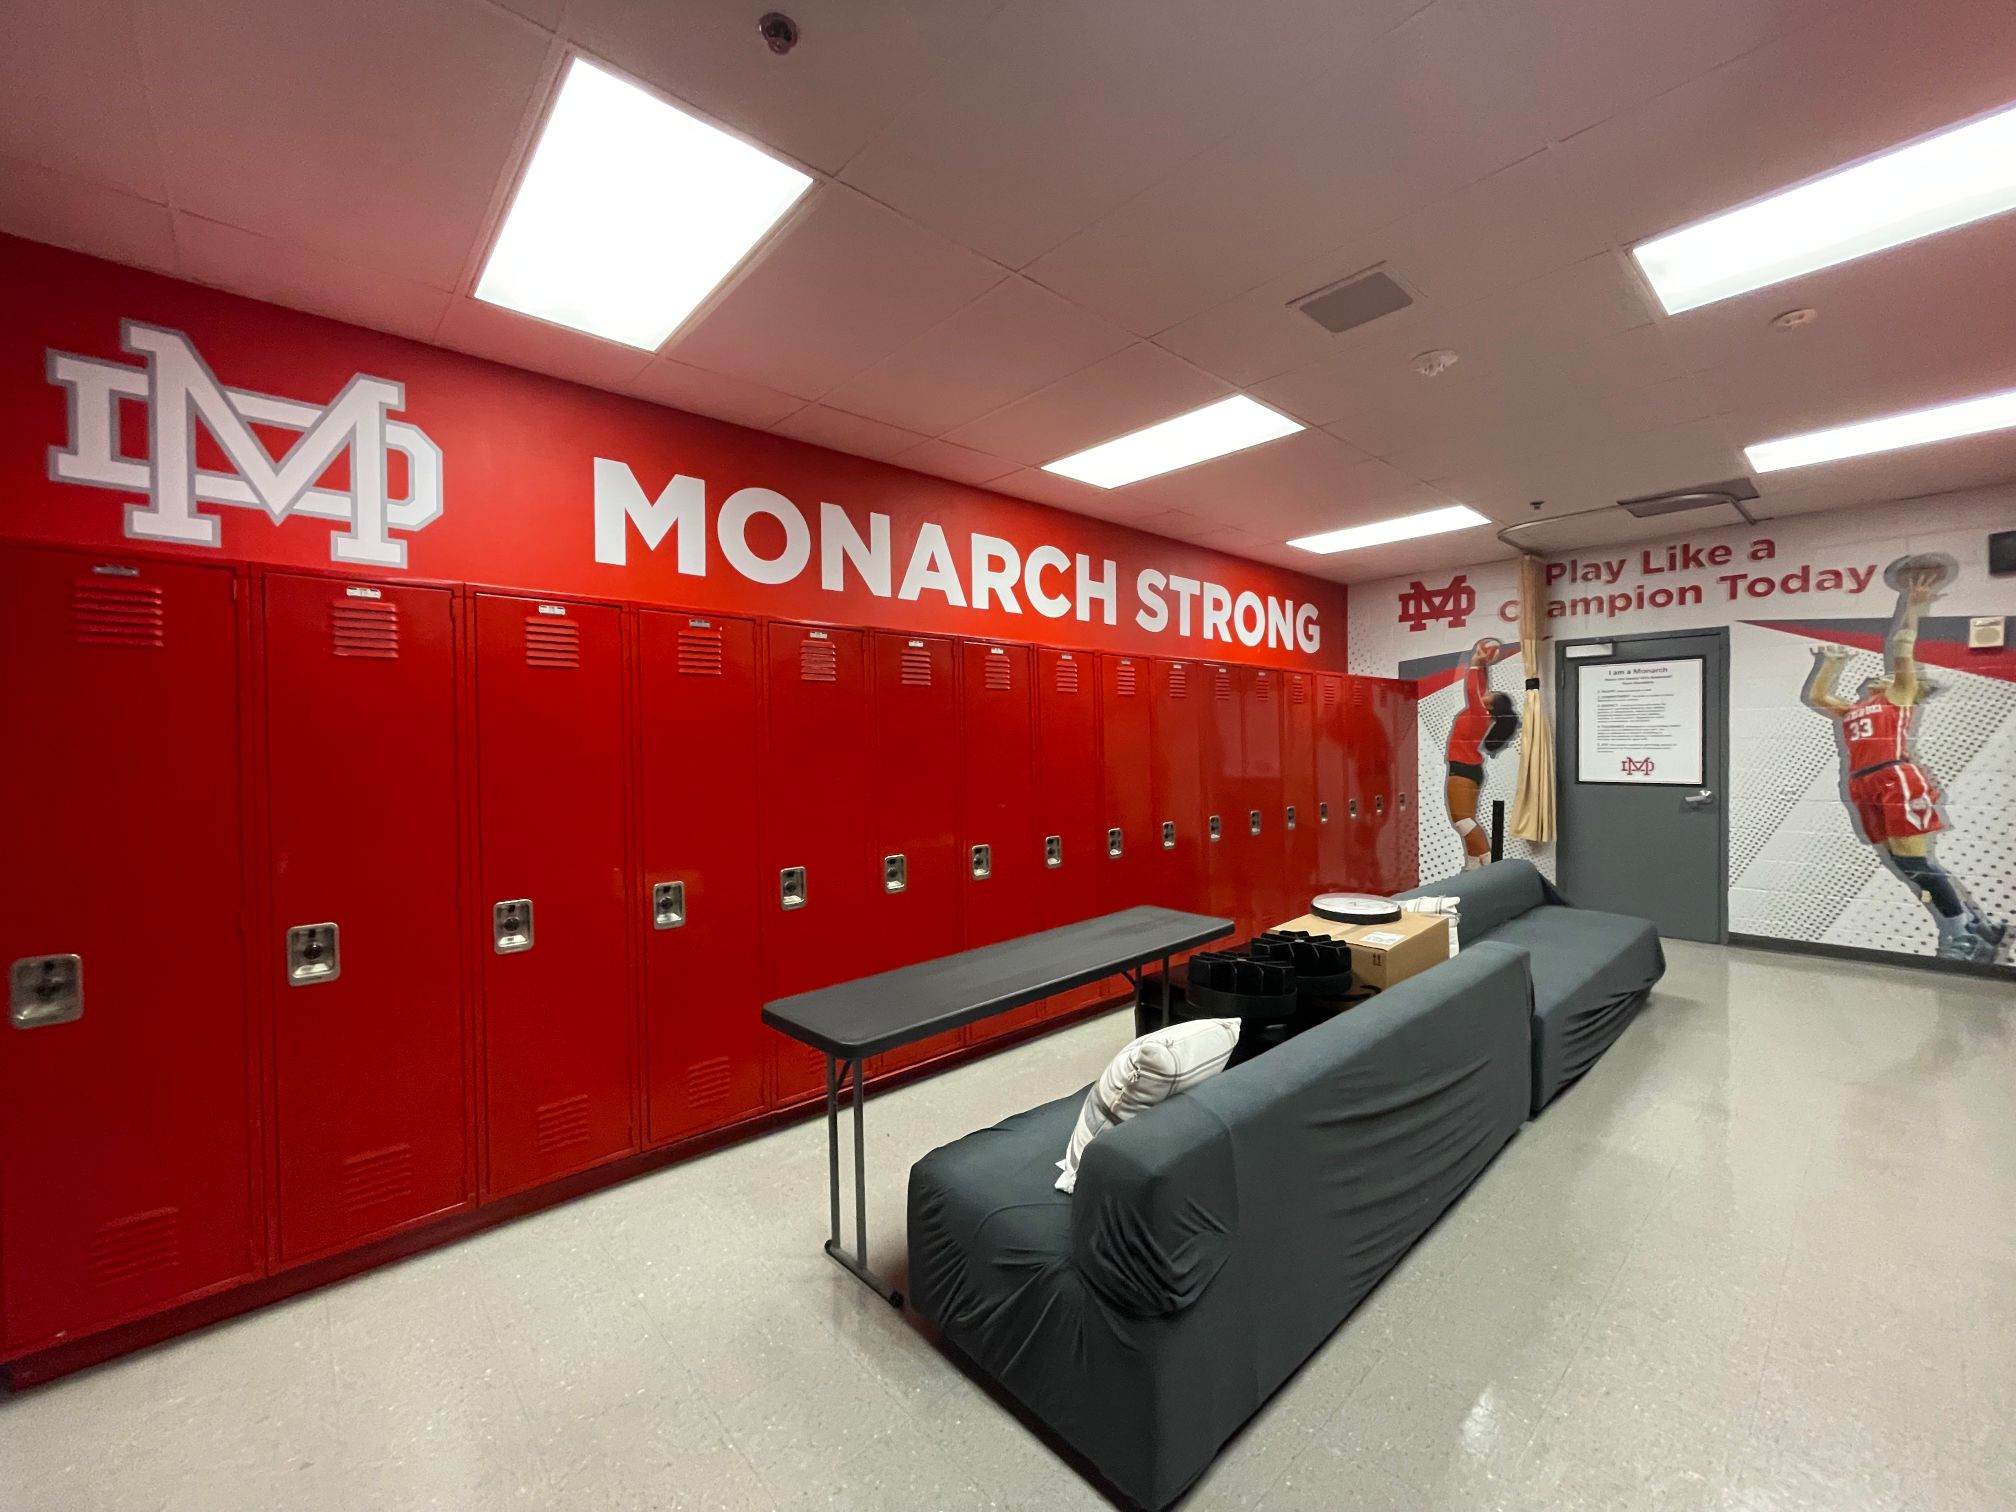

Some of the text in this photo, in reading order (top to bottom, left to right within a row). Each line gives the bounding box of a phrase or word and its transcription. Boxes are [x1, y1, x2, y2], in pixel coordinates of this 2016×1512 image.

[592, 456, 1321, 654] MONARCH STRONG
[1545, 538, 1777, 587] Play Like a
[1498, 563, 1879, 623] Campion Today
[1849, 718, 1873, 742] 33
